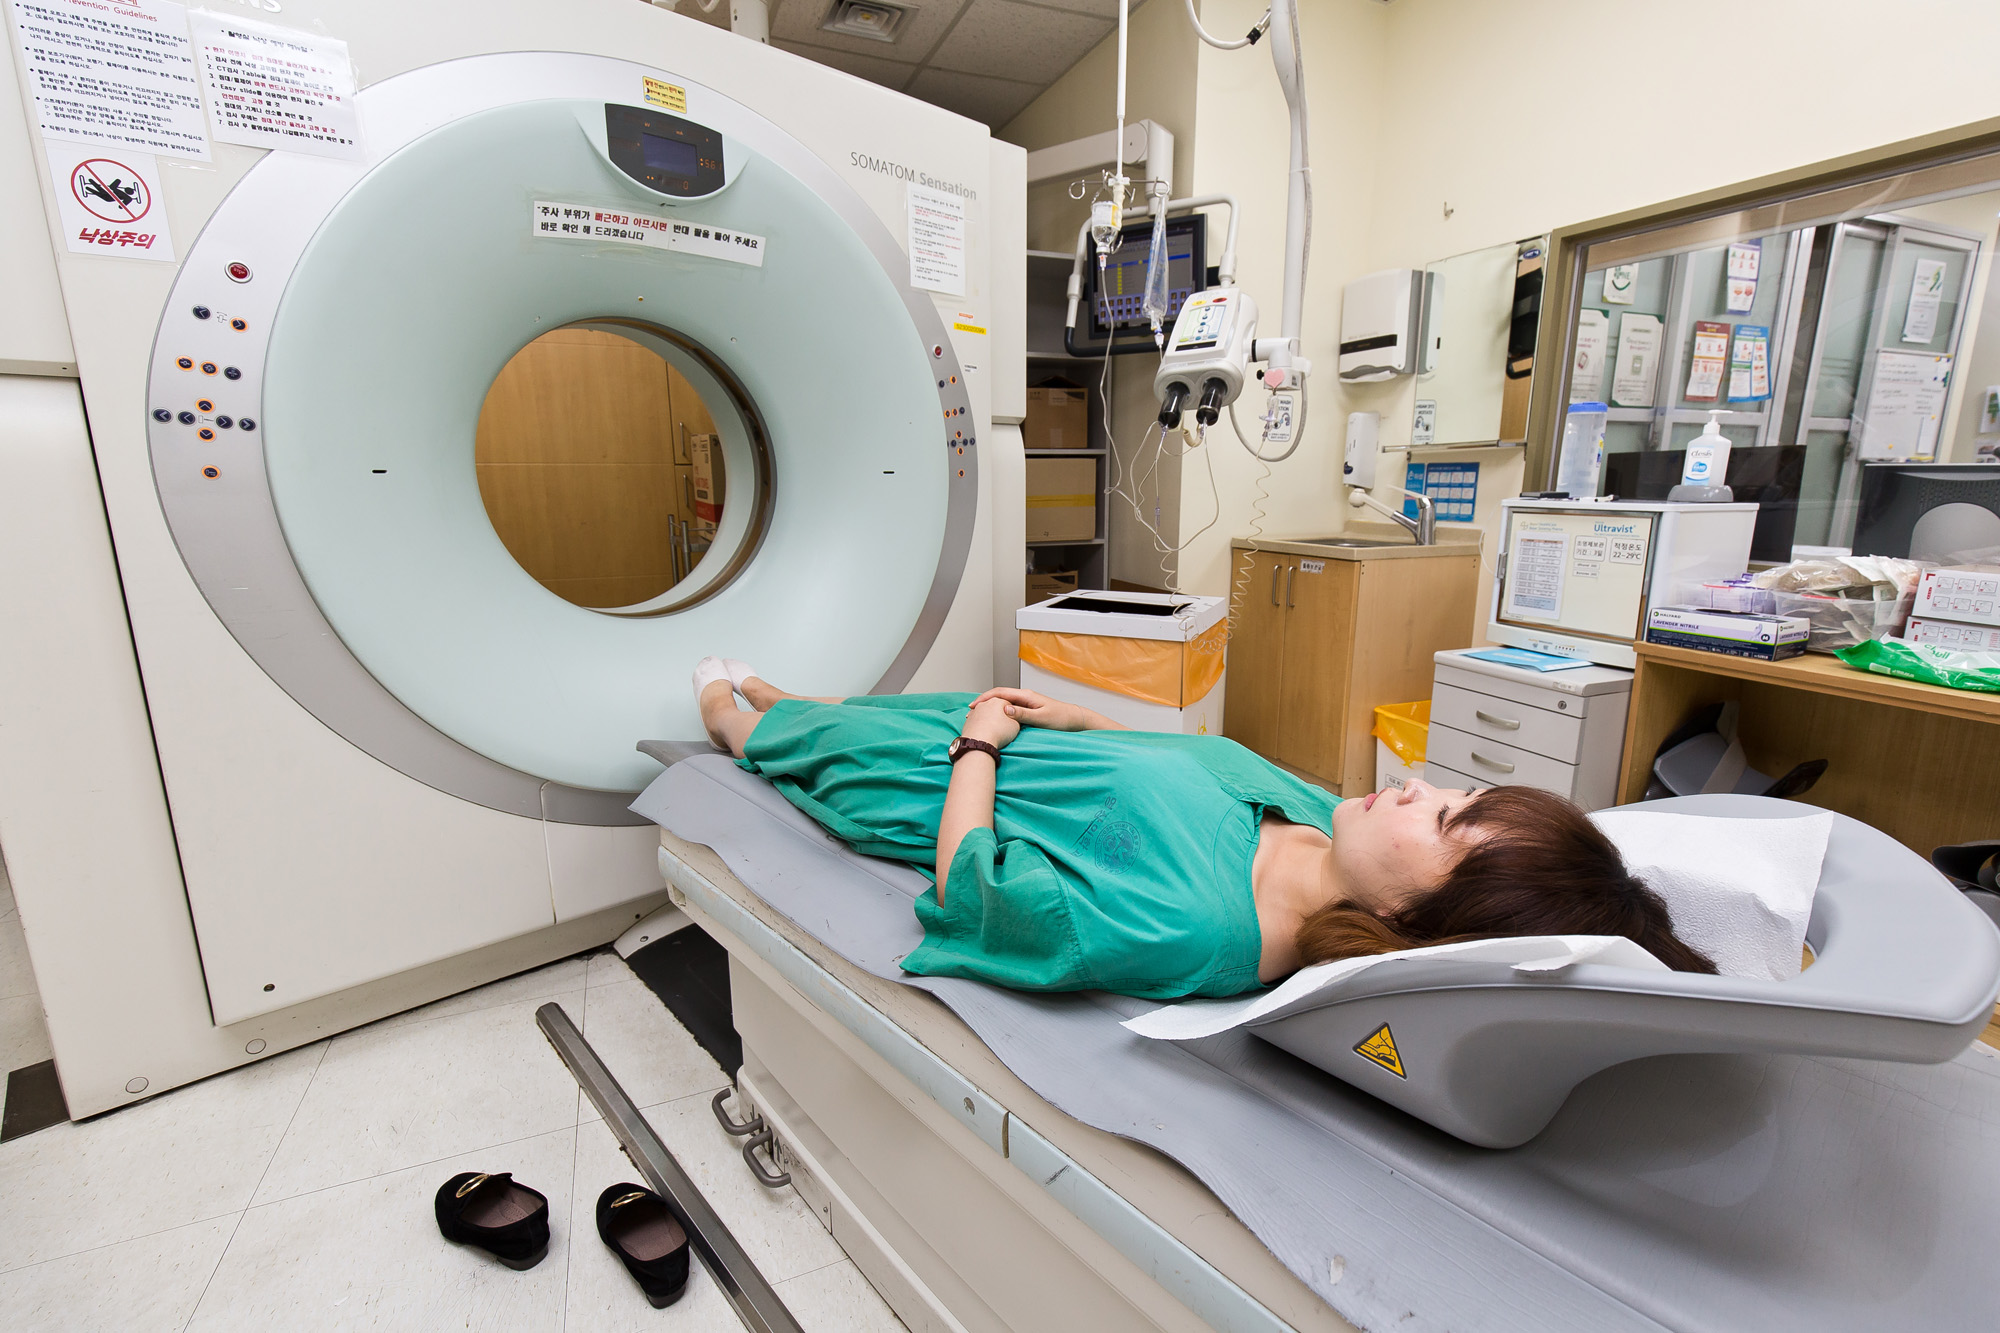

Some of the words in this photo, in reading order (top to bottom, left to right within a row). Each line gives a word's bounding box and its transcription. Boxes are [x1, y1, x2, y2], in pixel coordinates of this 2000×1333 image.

[64, 0, 109, 11] revention
[113, 7, 157, 22] Guidelines
[220, 83, 236, 91] Easy
[850, 151, 915, 182] SOMATOM
[919, 172, 977, 200] Sensation
[541, 206, 559, 217] 주사
[564, 208, 590, 220] 부위가
[633, 218, 667, 231] 아프시면
[673, 224, 690, 235] 반대
[694, 228, 710, 238] 팔을
[714, 232, 730, 243] 들어
[734, 236, 758, 248] 주세요
[541, 222, 558, 232] 바로
[562, 223, 578, 233] 확인
[595, 226, 644, 240] 드리겠습니다
[78, 227, 156, 249] 낙상주의
[1594, 524, 1633, 534] Ultravist
[1614, 542, 1642, 551] 적정온도
